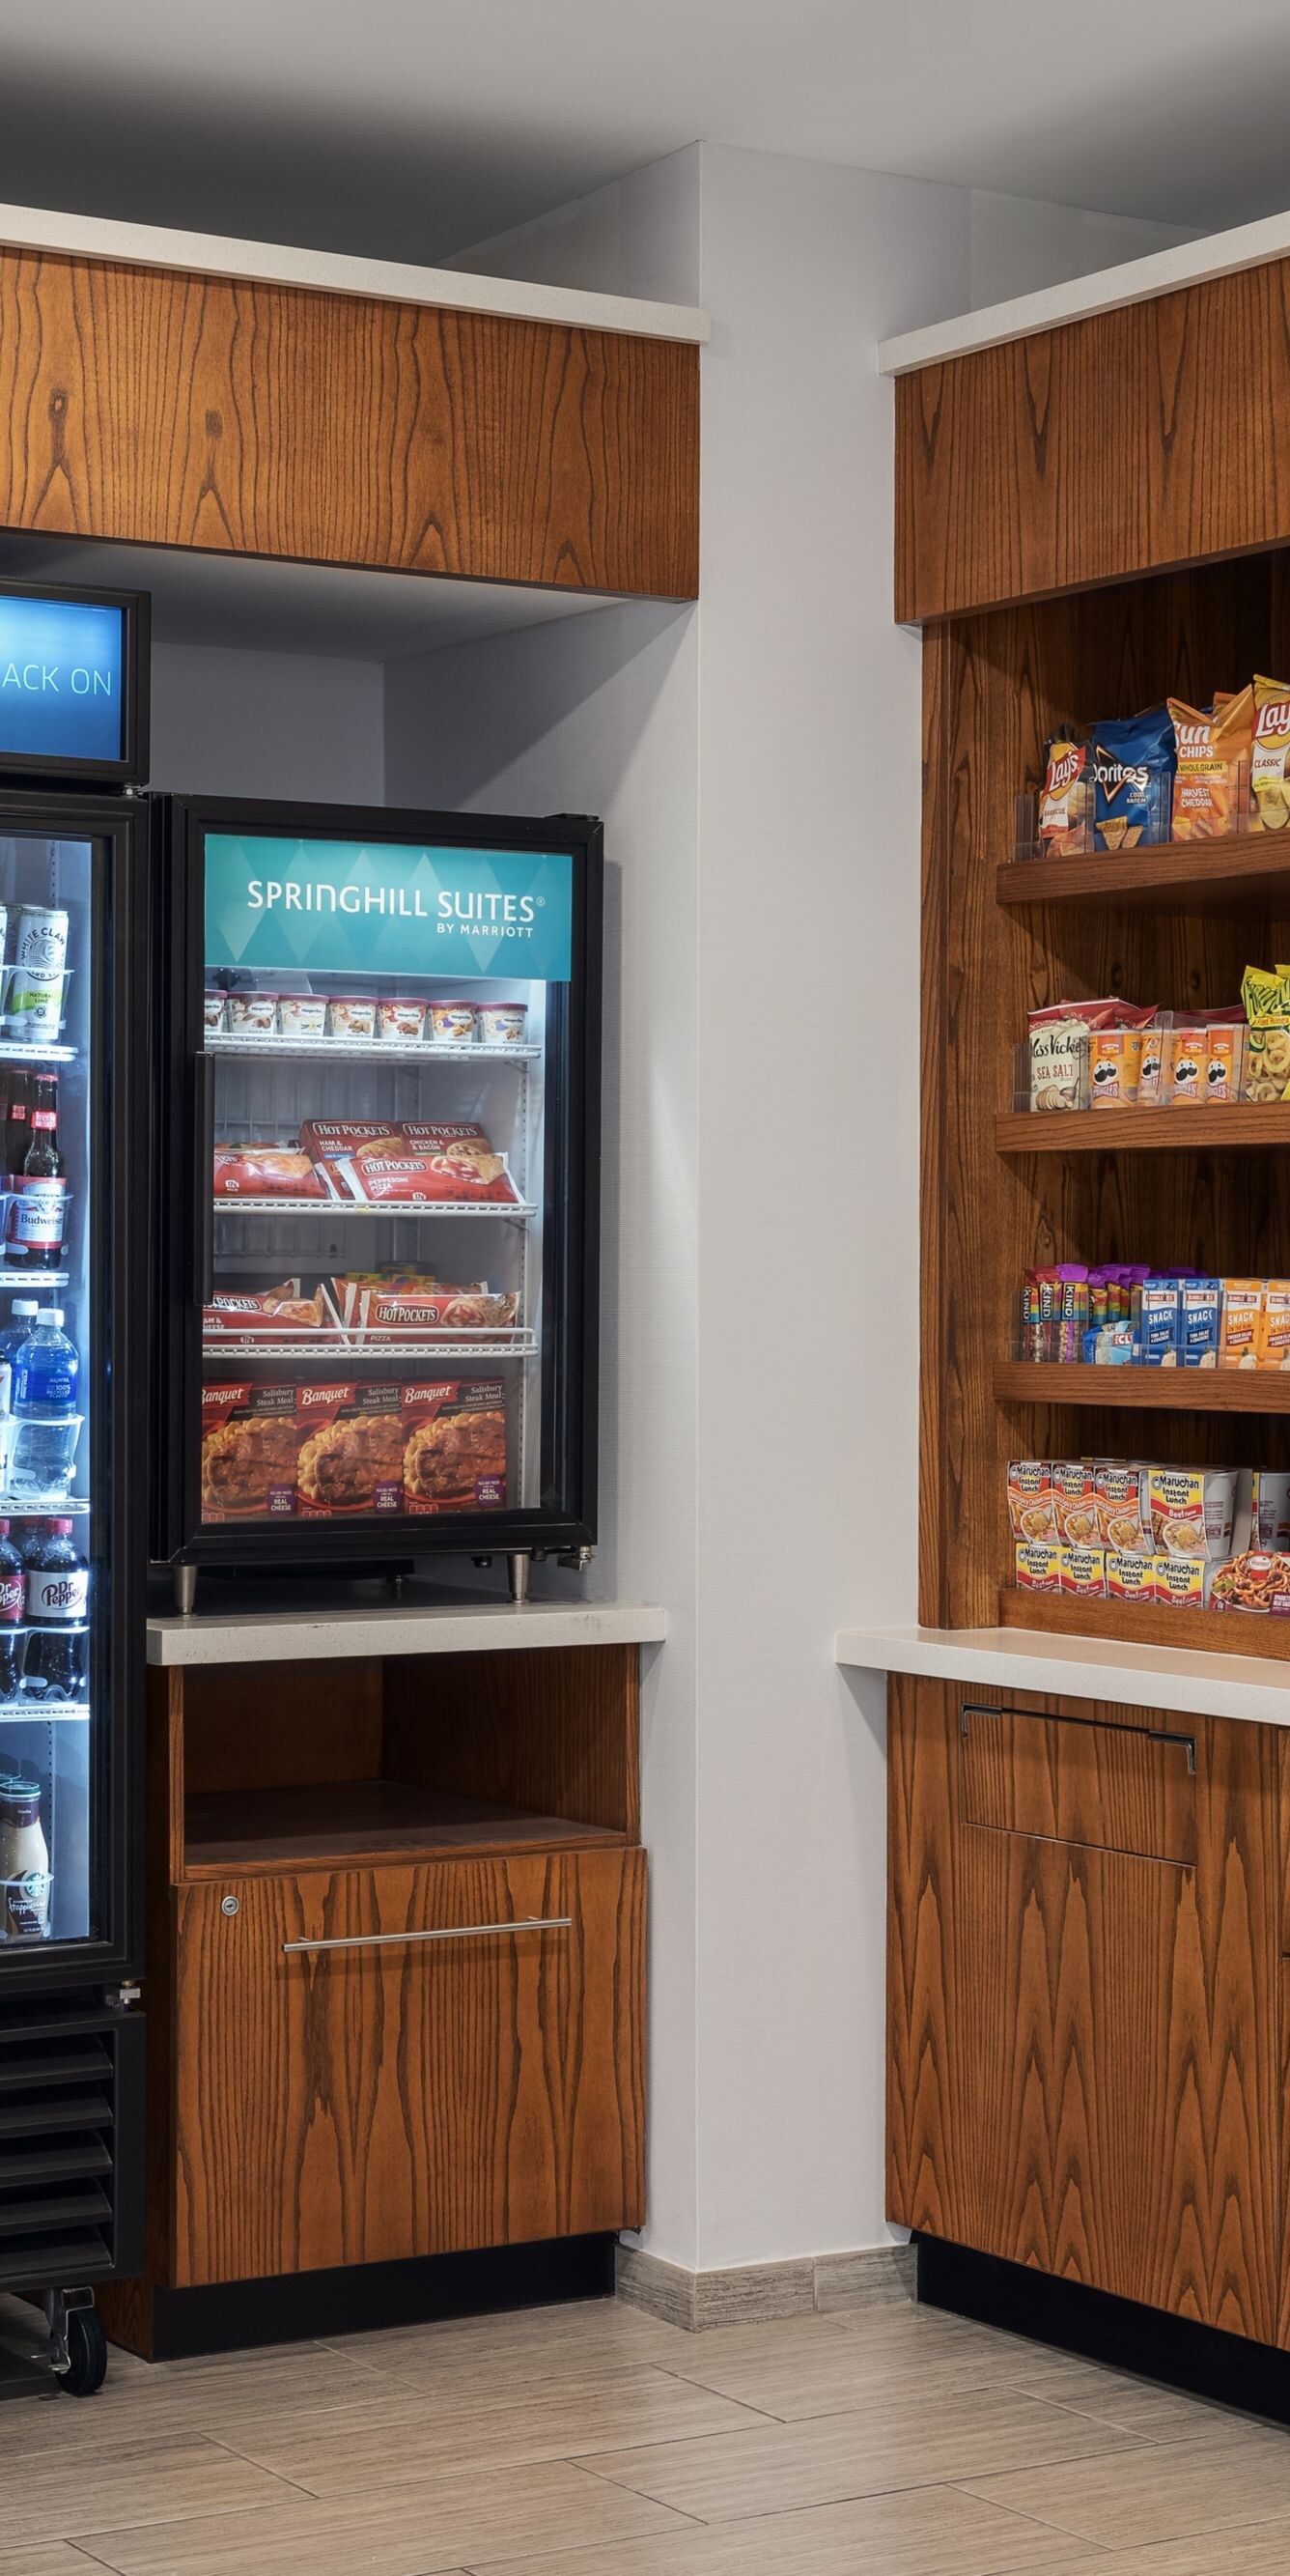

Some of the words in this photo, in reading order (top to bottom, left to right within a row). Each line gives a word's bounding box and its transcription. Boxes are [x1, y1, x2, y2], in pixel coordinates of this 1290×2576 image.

[71, 668, 111, 695] ON
[1180, 746, 1214, 758] CHIPS
[1254, 758, 1281, 767] CLASSIC
[1049, 751, 1079, 792] Lay's
[1181, 788, 1210, 798] HARVEST
[247, 880, 428, 918] SPRINGHILL
[436, 922, 454, 935] BY
[461, 924, 533, 938] MARRIOTT
[21, 929, 39, 959] WHITE
[42, 927, 65, 945] CLAW
[1037, 1067, 1051, 1080] SEA
[1053, 1064, 1074, 1077] SALT
[318, 1125, 341, 1135] HOT
[343, 1124, 390, 1136] POCKETS
[409, 1126, 428, 1135] HOT
[430, 1126, 477, 1136] POCKETS
[366, 1162, 385, 1173] HOT
[387, 1162, 424, 1171] POCKETS
[368, 1177, 408, 1186] PEPPERONI
[216, 1298, 257, 1310] POCKETS
[1023, 1287, 1032, 1319] KIND
[1042, 1285, 1053, 1317] KIND
[1065, 1286, 1075, 1316] KIND
[379, 1307, 399, 1320] HOT
[400, 1308, 435, 1321] POCKETS
[1149, 1310, 1173, 1324] SNACK
[1228, 1313, 1254, 1325] SNACK
[263, 1389, 294, 1398] Salisbury
[368, 1387, 400, 1396] Salisbury
[405, 1385, 453, 1403] Banquet
[471, 1385, 502, 1394] Salisbury
[257, 1397, 276, 1406] Steak
[301, 1387, 350, 1405] Banquet
[362, 1396, 380, 1405] Steak
[465, 1394, 483, 1402] Steak
[1017, 1466, 1051, 1477] Maruchan
[1060, 1468, 1093, 1480] Maruchan
[1103, 1473, 1136, 1485] Maruchan
[1161, 1475, 1199, 1489] Maruchan
[1163, 1488, 1190, 1497] Instant
[1165, 1496, 1187, 1505] Lunch
[1168, 1509, 1184, 1517] Beef
[1024, 1548, 1056, 1560] Maruchan
[1067, 1553, 1100, 1564] Maruchan
[1116, 1558, 1153, 1570] Maruchan
[1164, 1563, 1199, 1575] Maruchan
[1074, 1571, 1090, 1580] Lunch
[1166, 1574, 1191, 1583] Instant
[59, 1581, 74, 1594] Dr
[1169, 1582, 1188, 1591] Lunch
[42, 1584, 82, 1607] Pepper
[1171, 1596, 1186, 1604] Beef
